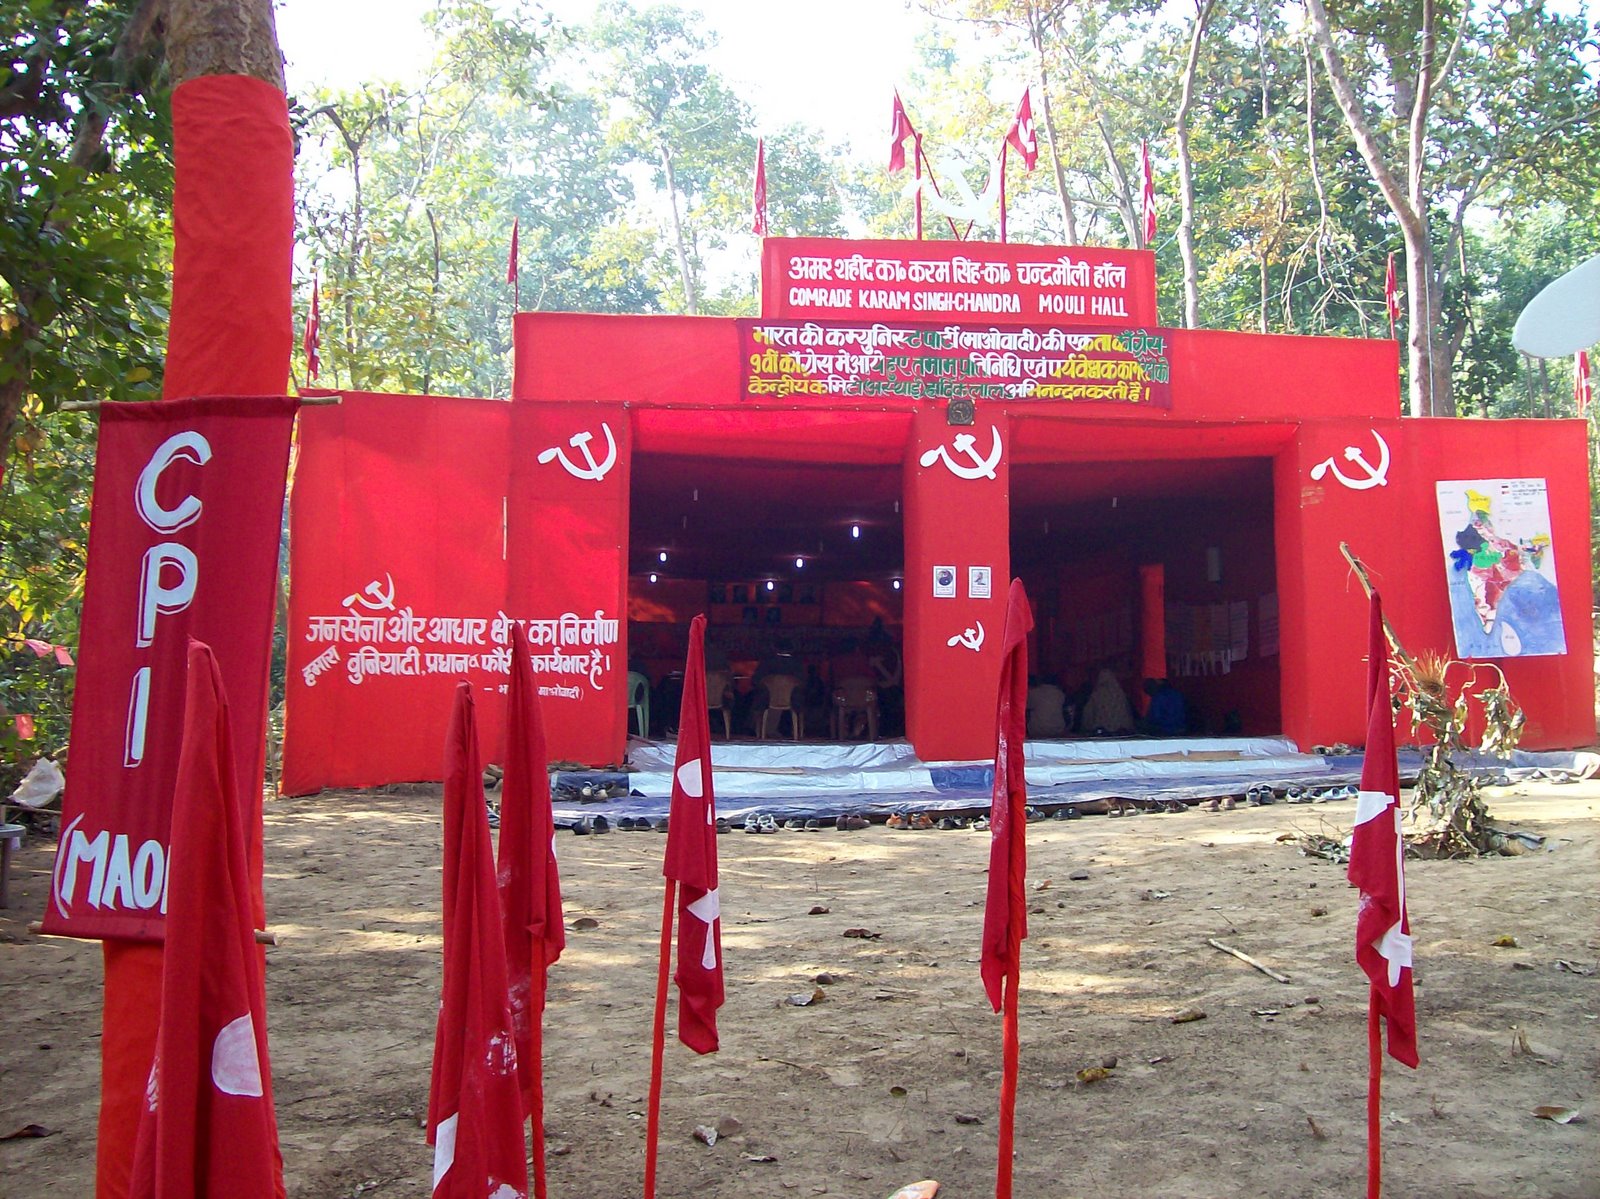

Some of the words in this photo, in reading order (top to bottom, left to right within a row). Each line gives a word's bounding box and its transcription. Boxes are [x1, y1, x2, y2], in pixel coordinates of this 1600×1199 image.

[788, 256, 833, 280] अमर
[834, 254, 874, 281] शहीद
[908, 260, 949, 283] करम
[1016, 256, 1090, 287] चन्द्रमौली
[1094, 262, 1126, 288] हॉल
[789, 287, 852, 308] COMRADE
[858, 289, 910, 310] KARAM
[1039, 294, 1085, 314] MOULI
[1092, 296, 1128, 317] HALL
[753, 327, 798, 346] भारत
[800, 323, 825, 346] की
[826, 324, 923, 354] कम्युनिस्ट
[1042, 327, 1065, 351] की
[1067, 333, 1112, 353] एकता
[886, 356, 912, 381] हुए
[913, 357, 957, 377] तमाम
[959, 352, 1021, 380] प्रतिनिधि
[1024, 356, 1046, 378] एवं
[748, 375, 810, 397] केन्द्रीय
[969, 384, 1006, 399] लाल
[1005, 378, 1087, 401] अभिनन्दन
[1087, 380, 1128, 400] करती
[306, 608, 386, 643] जनसेना
[386, 606, 427, 643] और
[426, 616, 487, 645] आधार
[528, 619, 559, 646] का
[559, 610, 618, 646] निर्माण
[302, 645, 341, 686] हमारा
[425, 653, 469, 674] प्रधान
